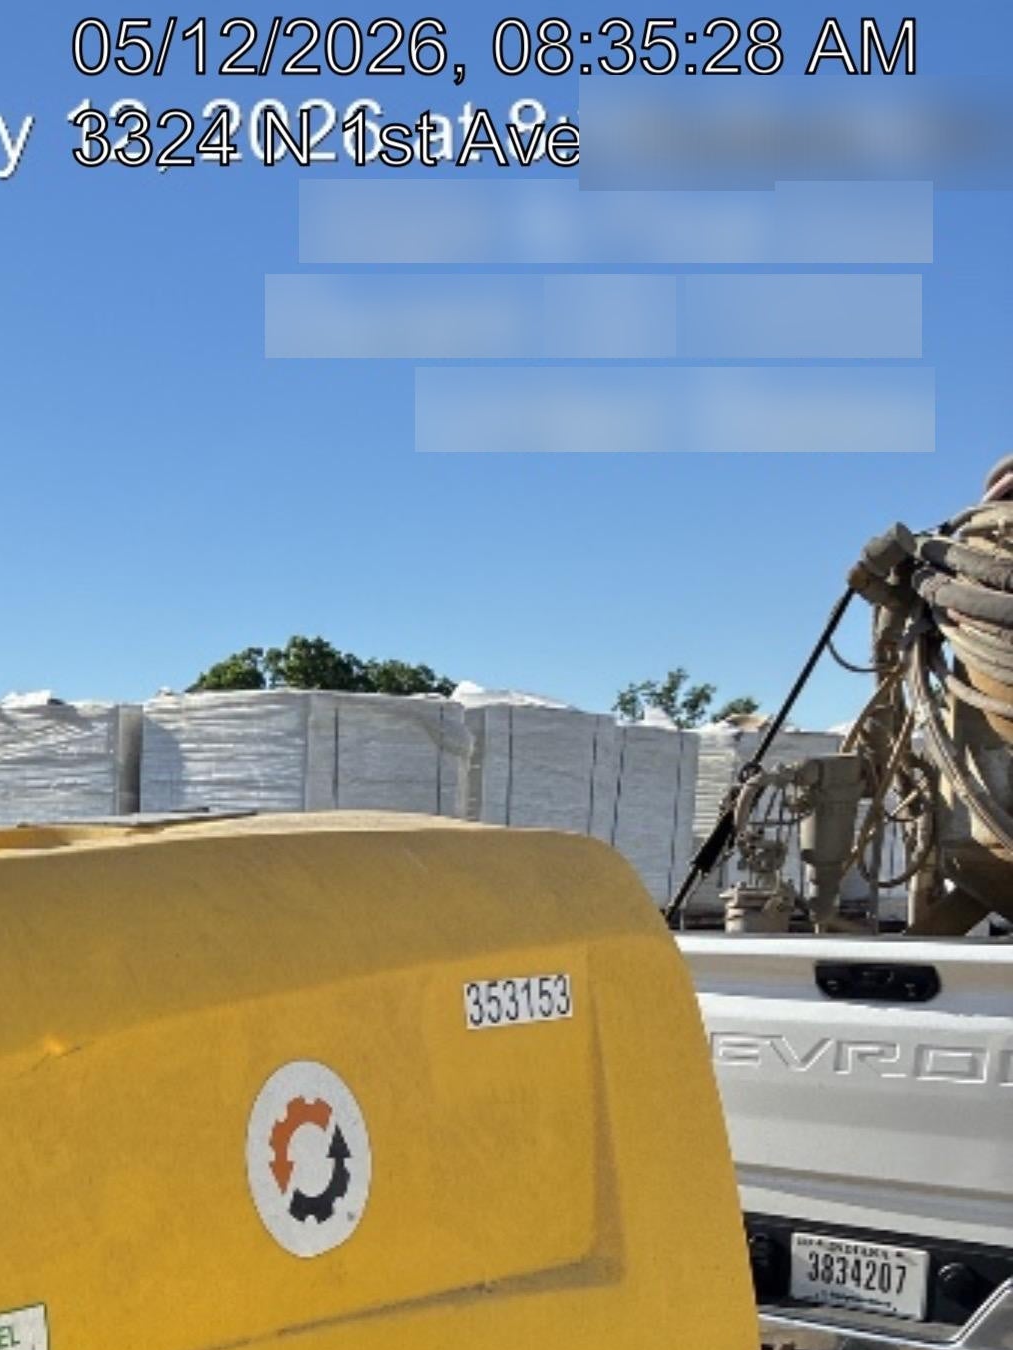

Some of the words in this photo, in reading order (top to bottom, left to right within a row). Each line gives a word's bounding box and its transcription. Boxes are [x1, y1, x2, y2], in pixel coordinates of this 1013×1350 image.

[467, 974, 570, 1025] 353153
[710, 1032, 1013, 1087] EVRO
[808, 1251, 907, 1294] 3834207
